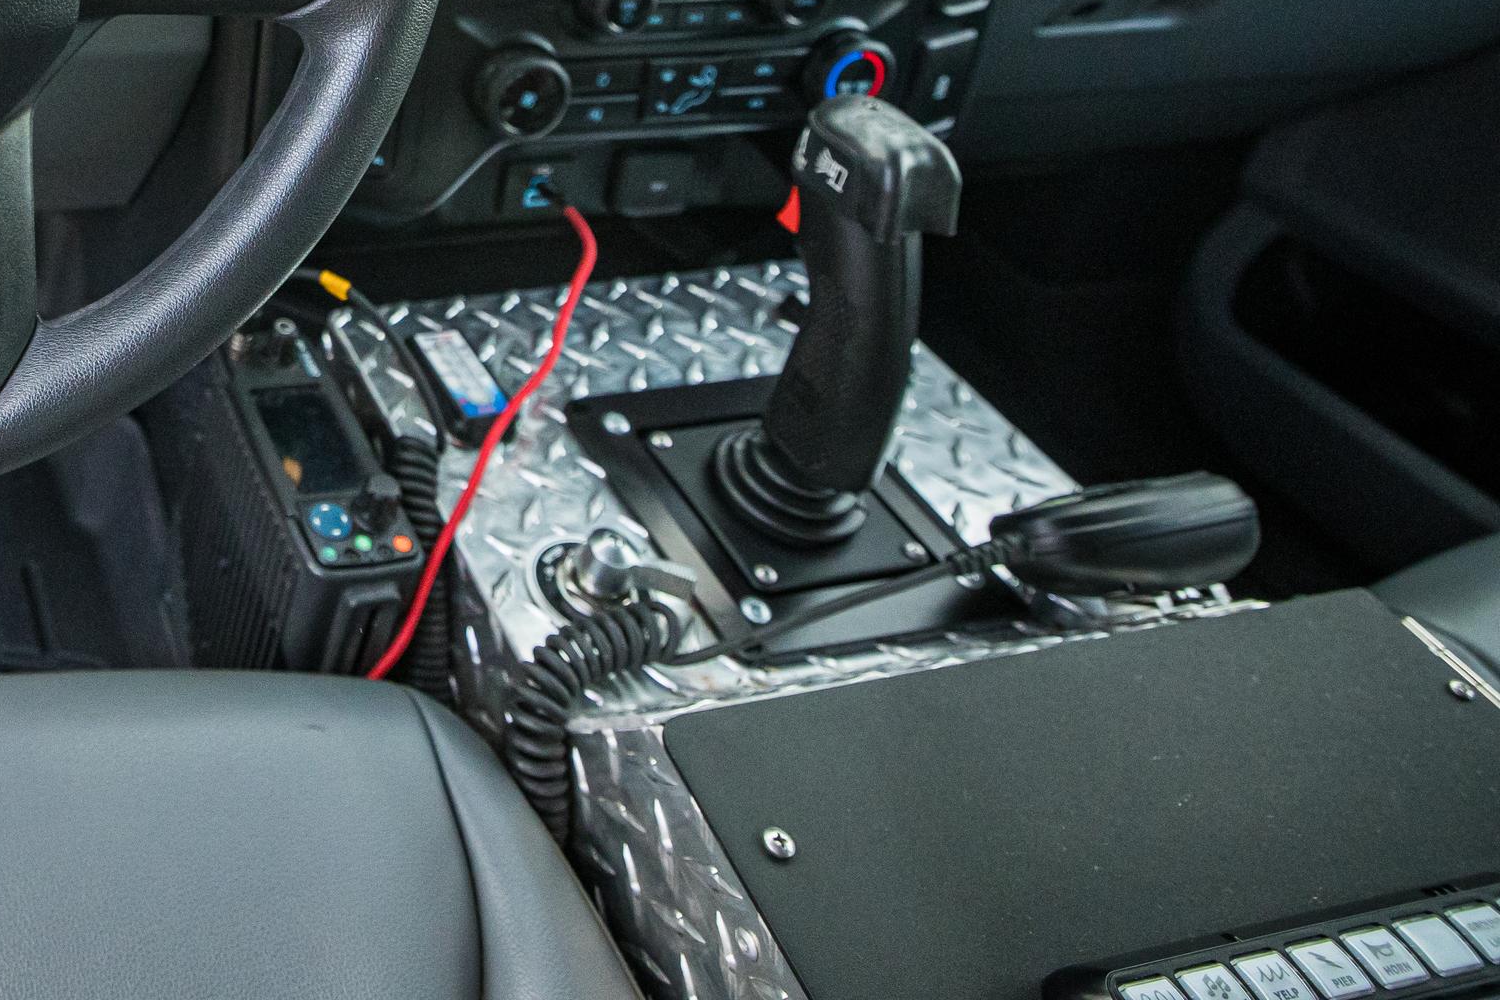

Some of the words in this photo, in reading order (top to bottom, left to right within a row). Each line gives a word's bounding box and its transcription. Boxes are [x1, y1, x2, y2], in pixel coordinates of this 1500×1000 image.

[1383, 961, 1414, 977] HORN
[1331, 975, 1357, 989] PIER
[1272, 987, 1300, 1000] YELP
